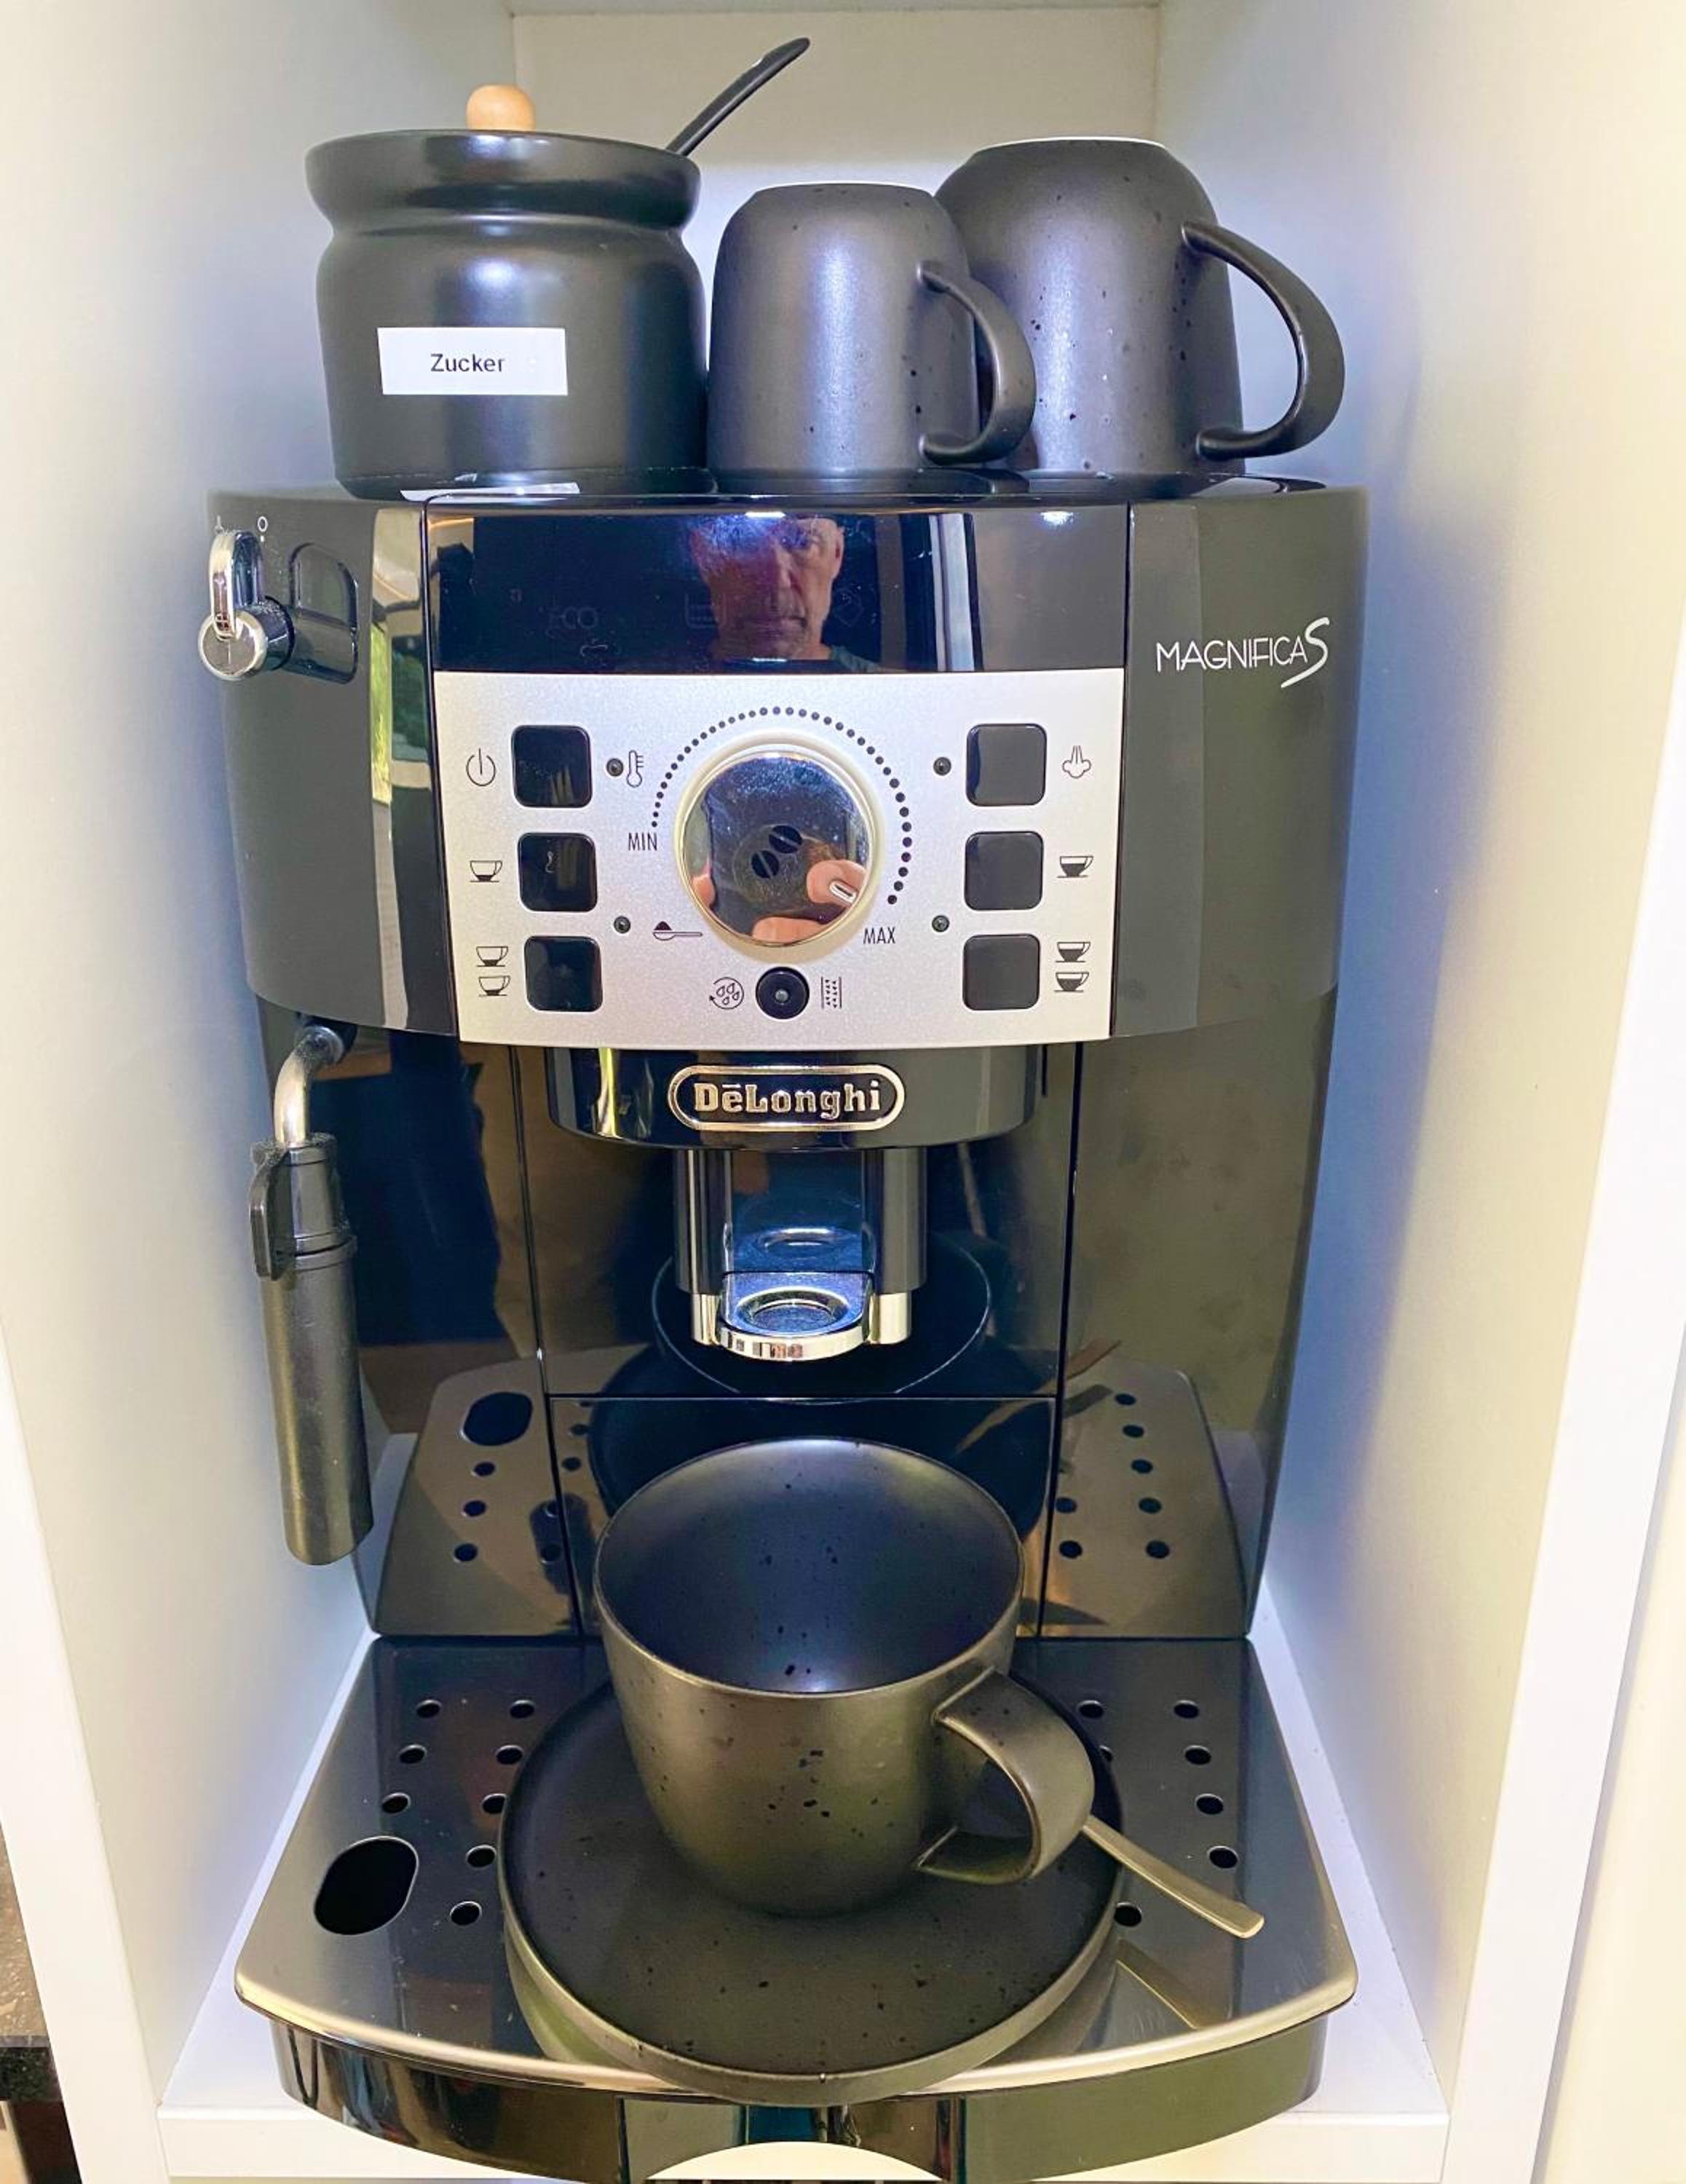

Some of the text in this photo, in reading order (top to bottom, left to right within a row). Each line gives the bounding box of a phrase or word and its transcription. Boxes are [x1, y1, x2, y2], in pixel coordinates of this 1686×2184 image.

[430, 352, 506, 373] Zucker
[628, 831, 658, 852] MIN
[862, 926, 897, 945] MAX
